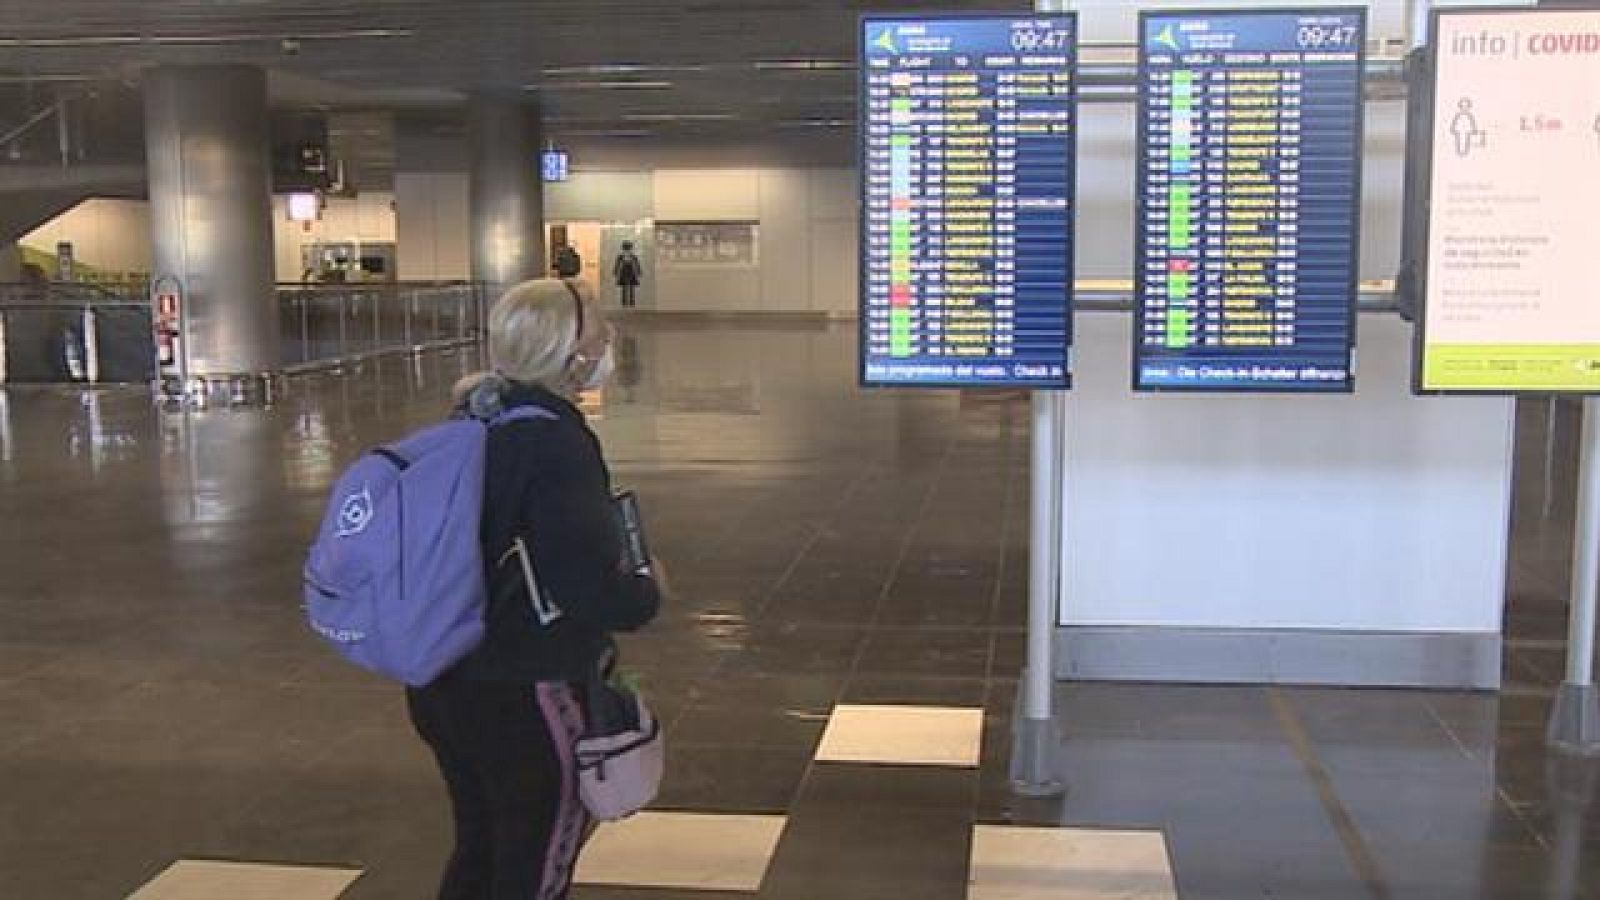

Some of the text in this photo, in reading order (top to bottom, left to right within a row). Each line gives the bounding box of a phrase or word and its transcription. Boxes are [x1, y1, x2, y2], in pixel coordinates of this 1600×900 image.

[1011, 29, 1069, 51] 09:47
[1298, 26, 1357, 49] 09:47
[1452, 29, 1600, 56] info COVID
